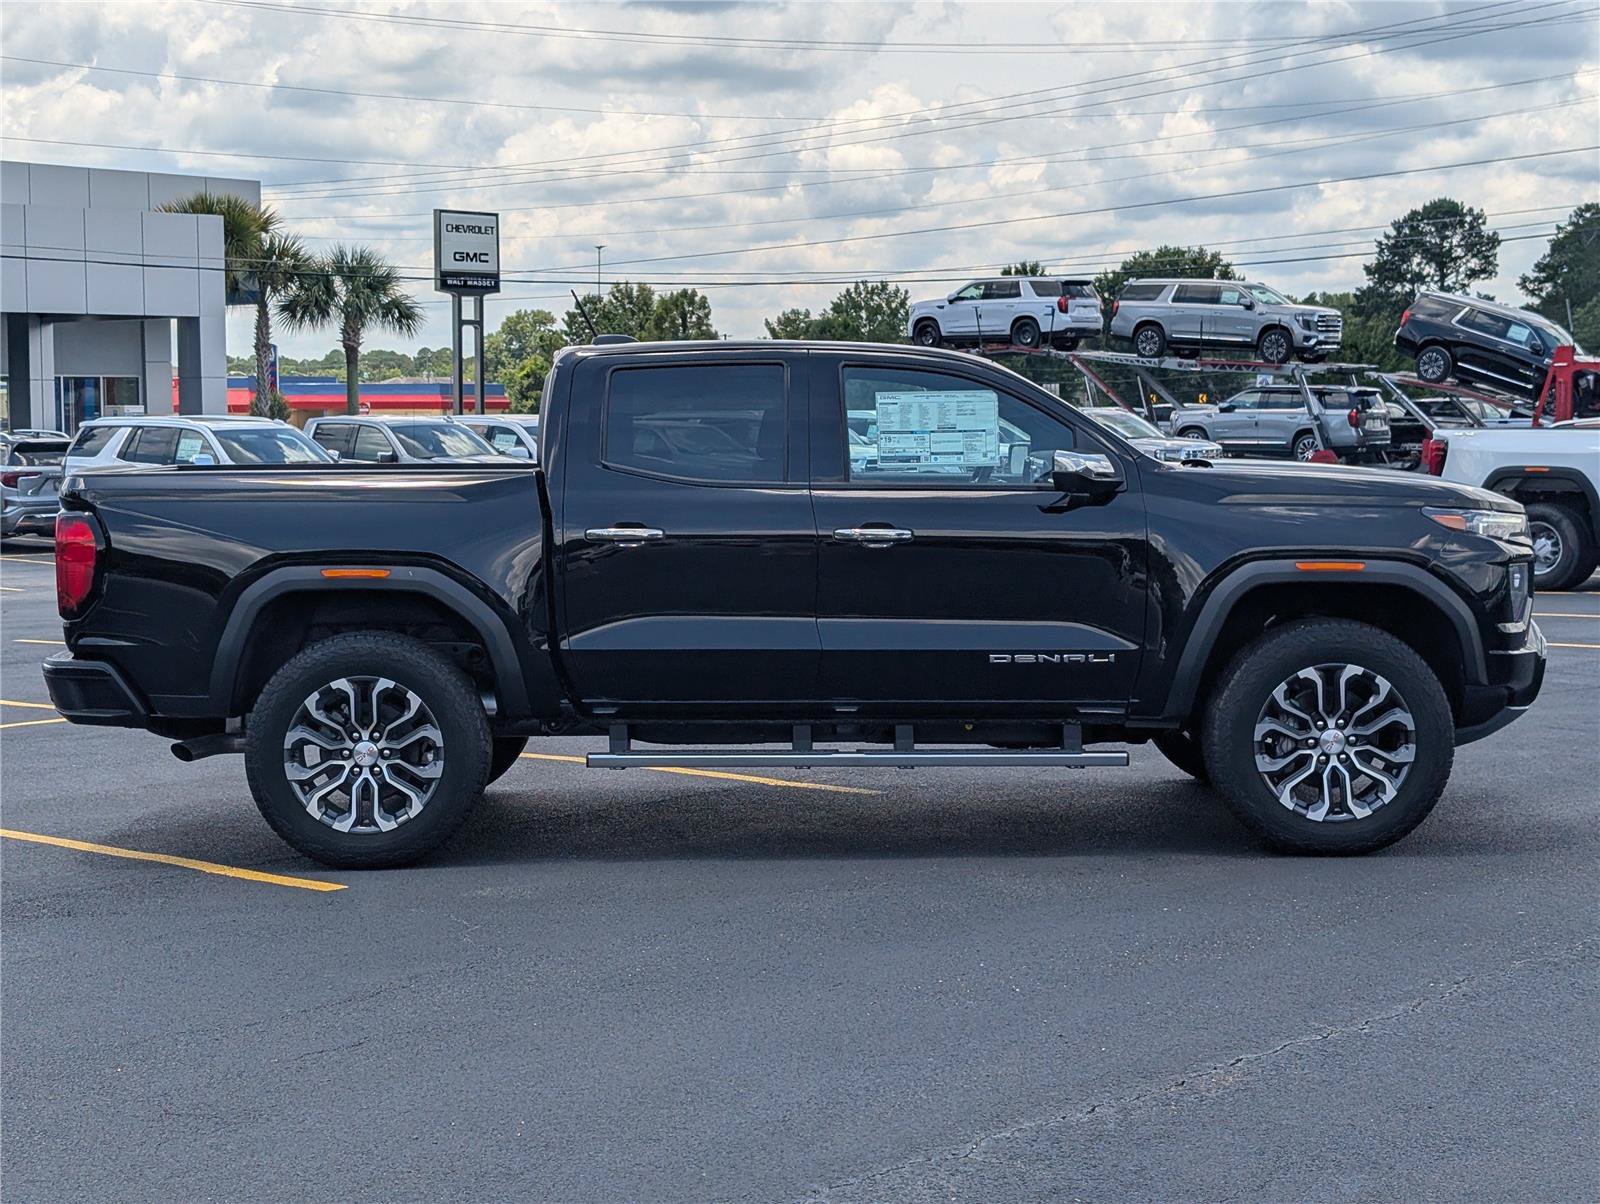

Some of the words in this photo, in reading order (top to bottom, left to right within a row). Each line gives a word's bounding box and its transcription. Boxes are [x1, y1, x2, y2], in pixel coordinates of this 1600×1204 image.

[445, 223, 495, 235] CHEVROLET
[453, 251, 489, 263] GMC
[989, 654, 1115, 663] DENALI
